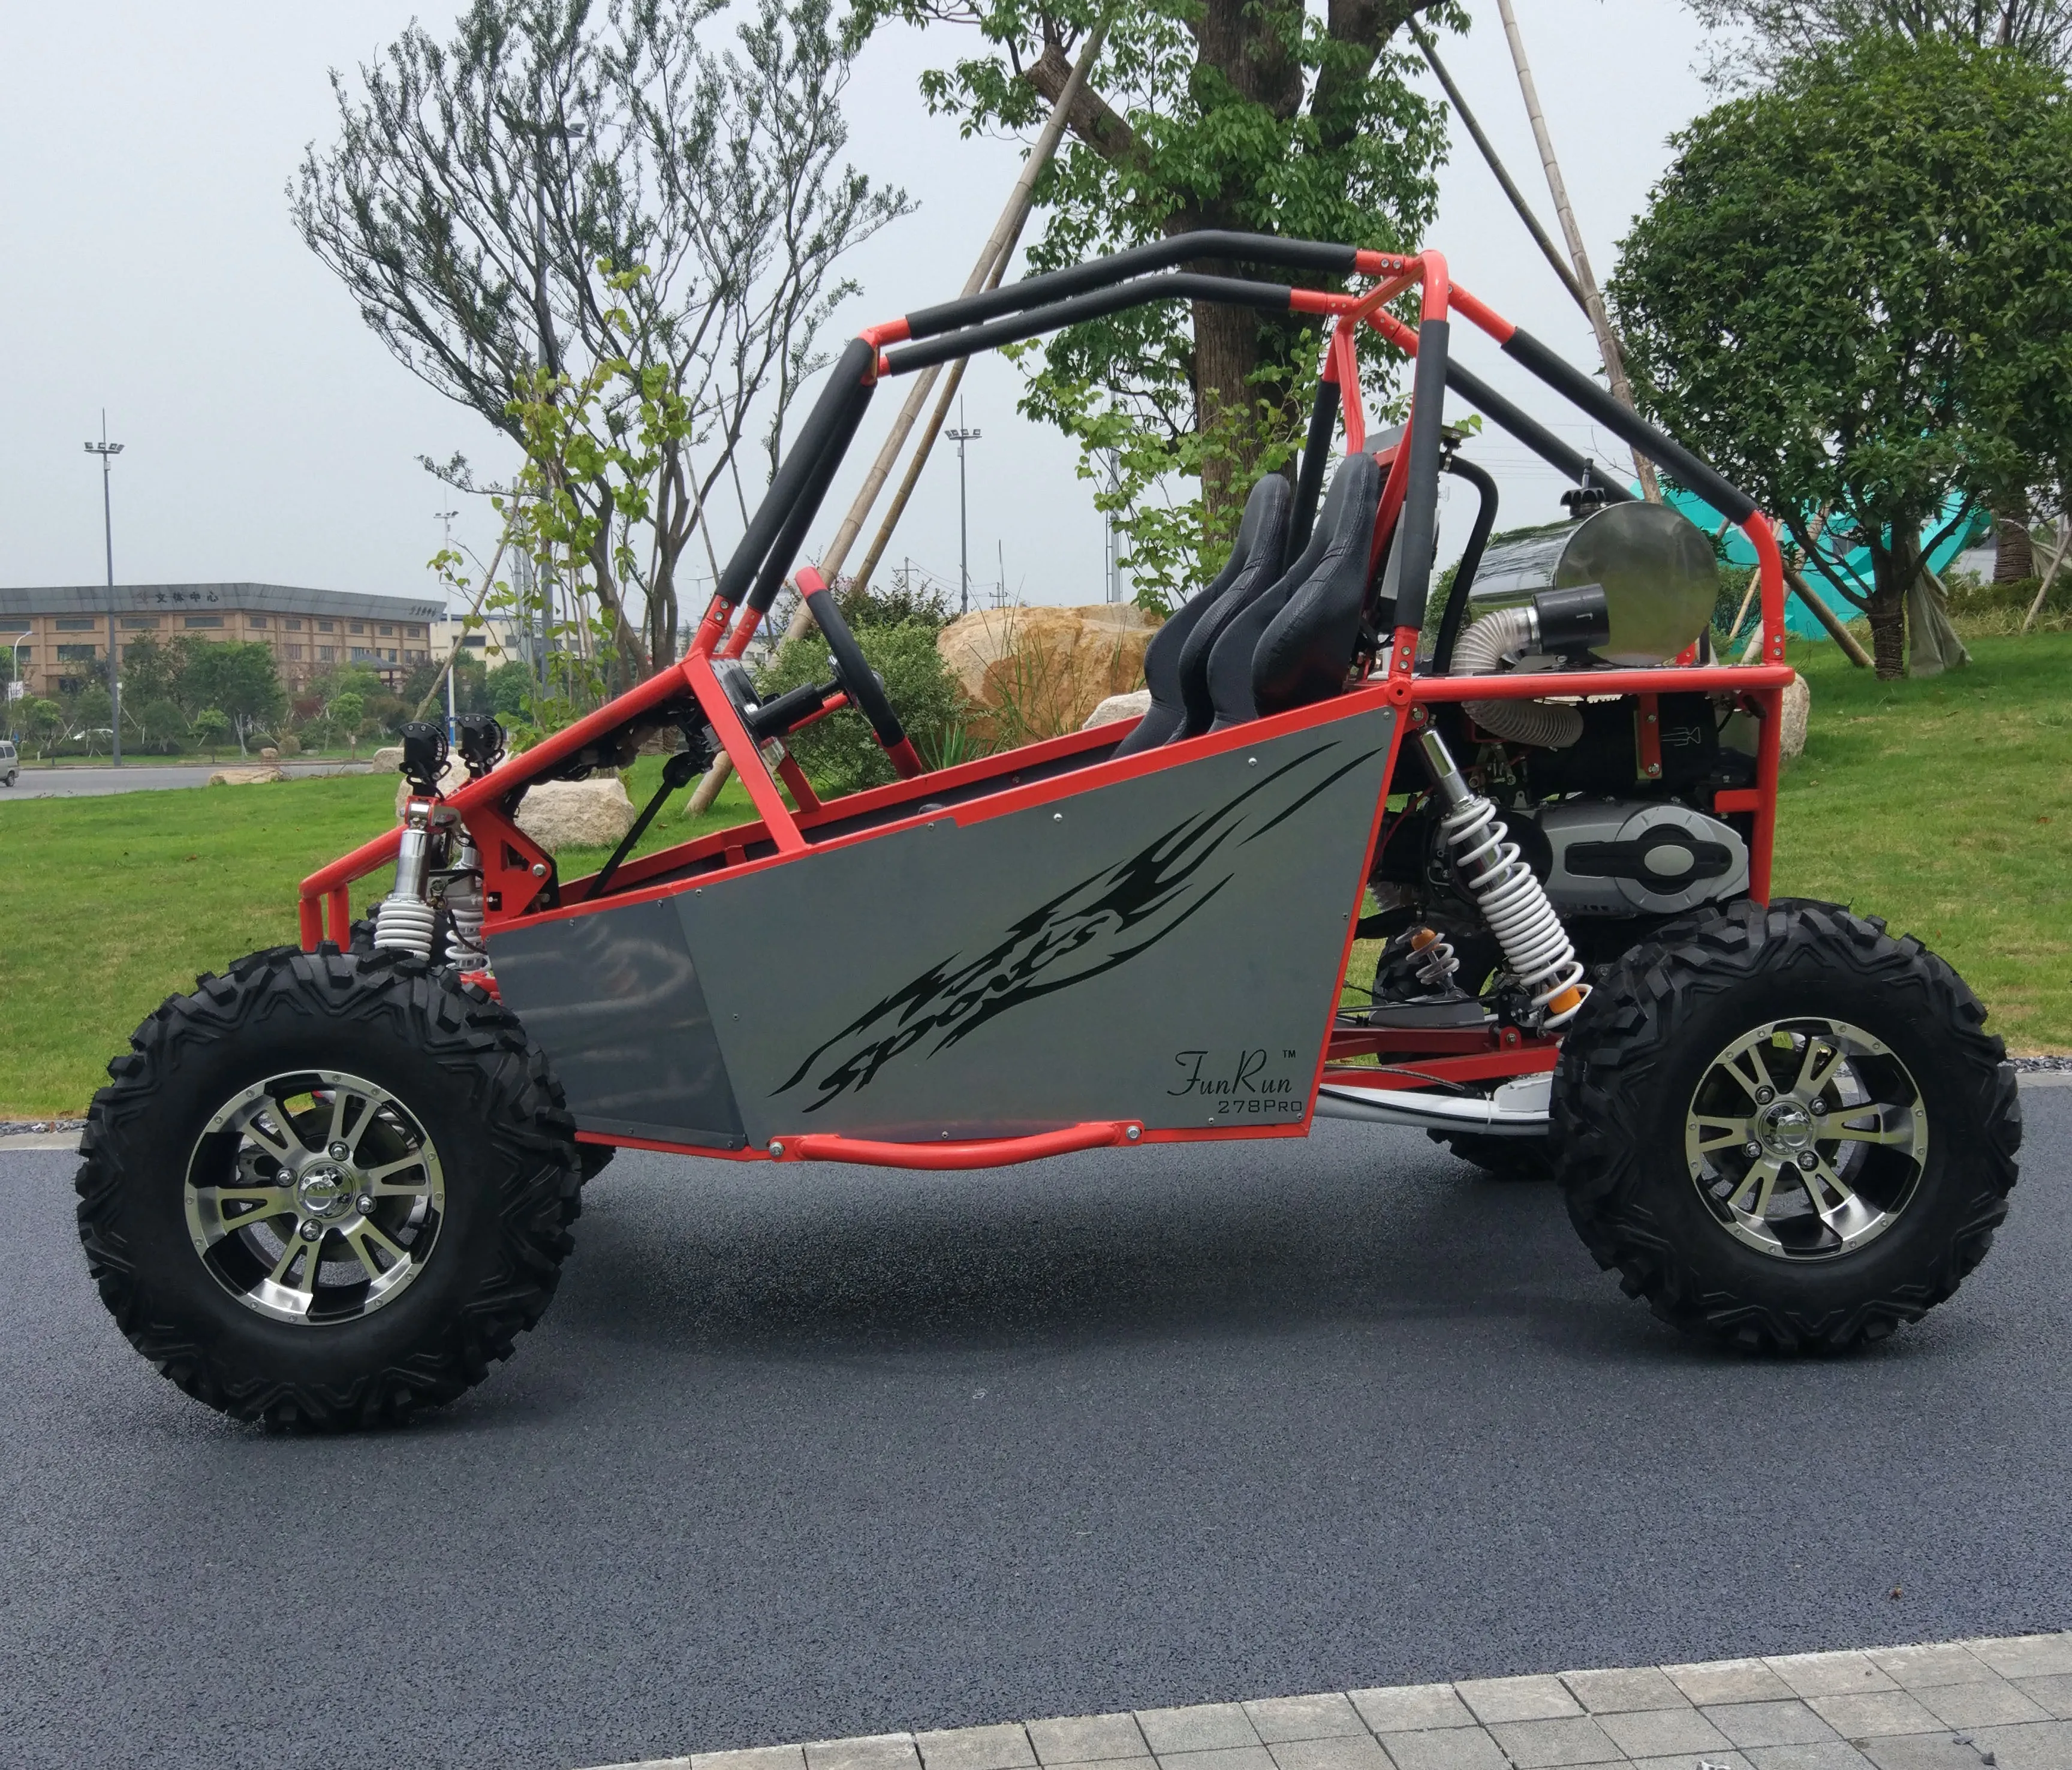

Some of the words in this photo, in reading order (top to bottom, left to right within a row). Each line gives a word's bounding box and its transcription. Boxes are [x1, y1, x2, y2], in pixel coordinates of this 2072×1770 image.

[1167, 1049, 1292, 1096] FunRun
[1282, 1050, 1296, 1058] TM
[1218, 1100, 1303, 1114] 278PRO
